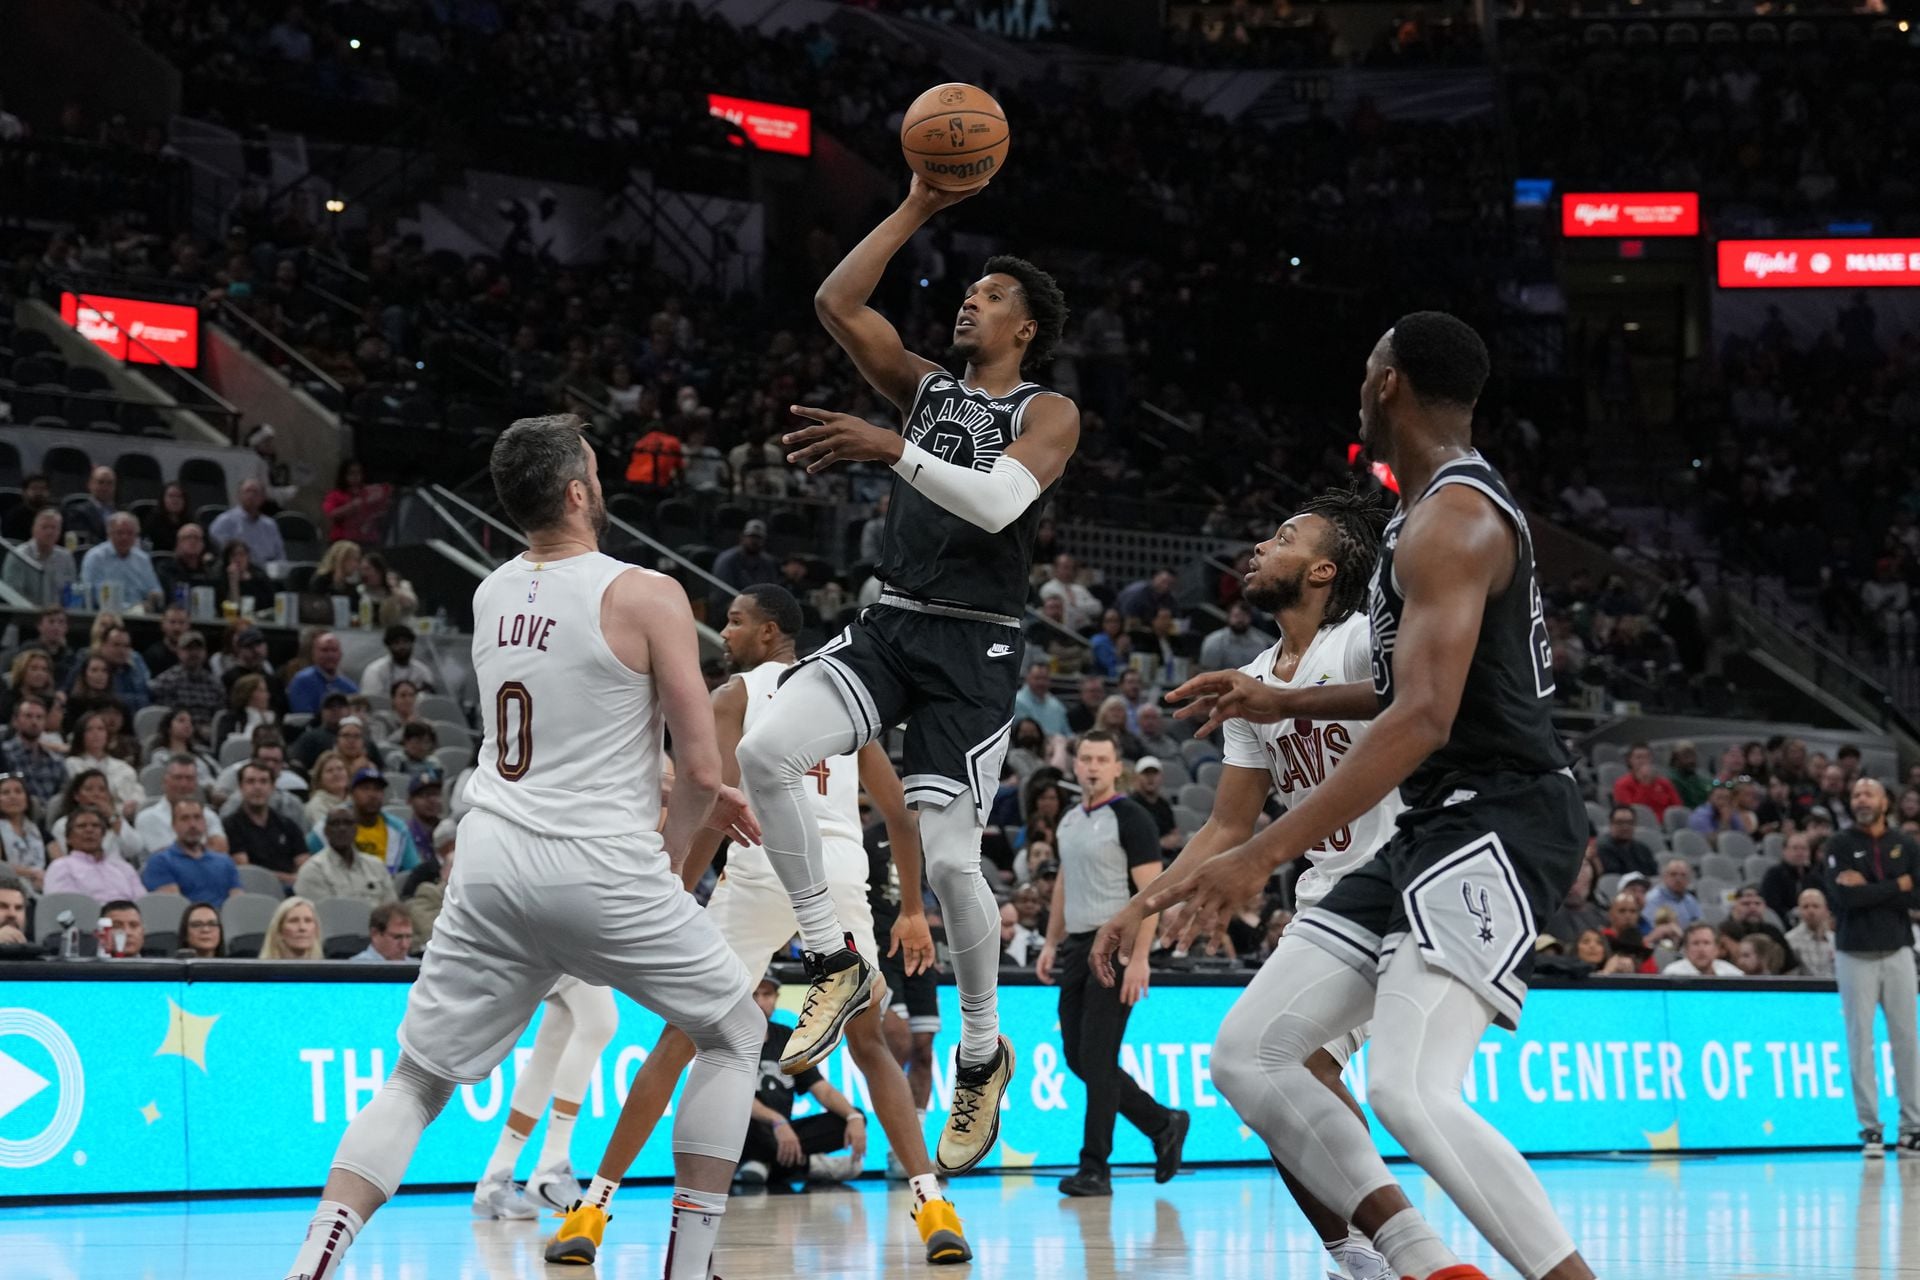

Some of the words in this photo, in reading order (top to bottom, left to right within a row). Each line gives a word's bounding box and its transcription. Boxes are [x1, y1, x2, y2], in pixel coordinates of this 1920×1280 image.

[924, 156, 995, 179] Wilson
[911, 404, 936, 446] AN
[936, 398, 1003, 474] ANTONIO
[933, 432, 963, 464] 7
[498, 614, 557, 652] LOVE
[496, 681, 533, 782] 0
[1265, 722, 1352, 794] CAVS
[300, 1048, 385, 1123] TH
[1031, 1043, 1068, 1111] &
[1518, 1040, 1687, 1103] CENTER
[1701, 1040, 1753, 1101] OF
[1765, 1041, 1844, 1099] THE
